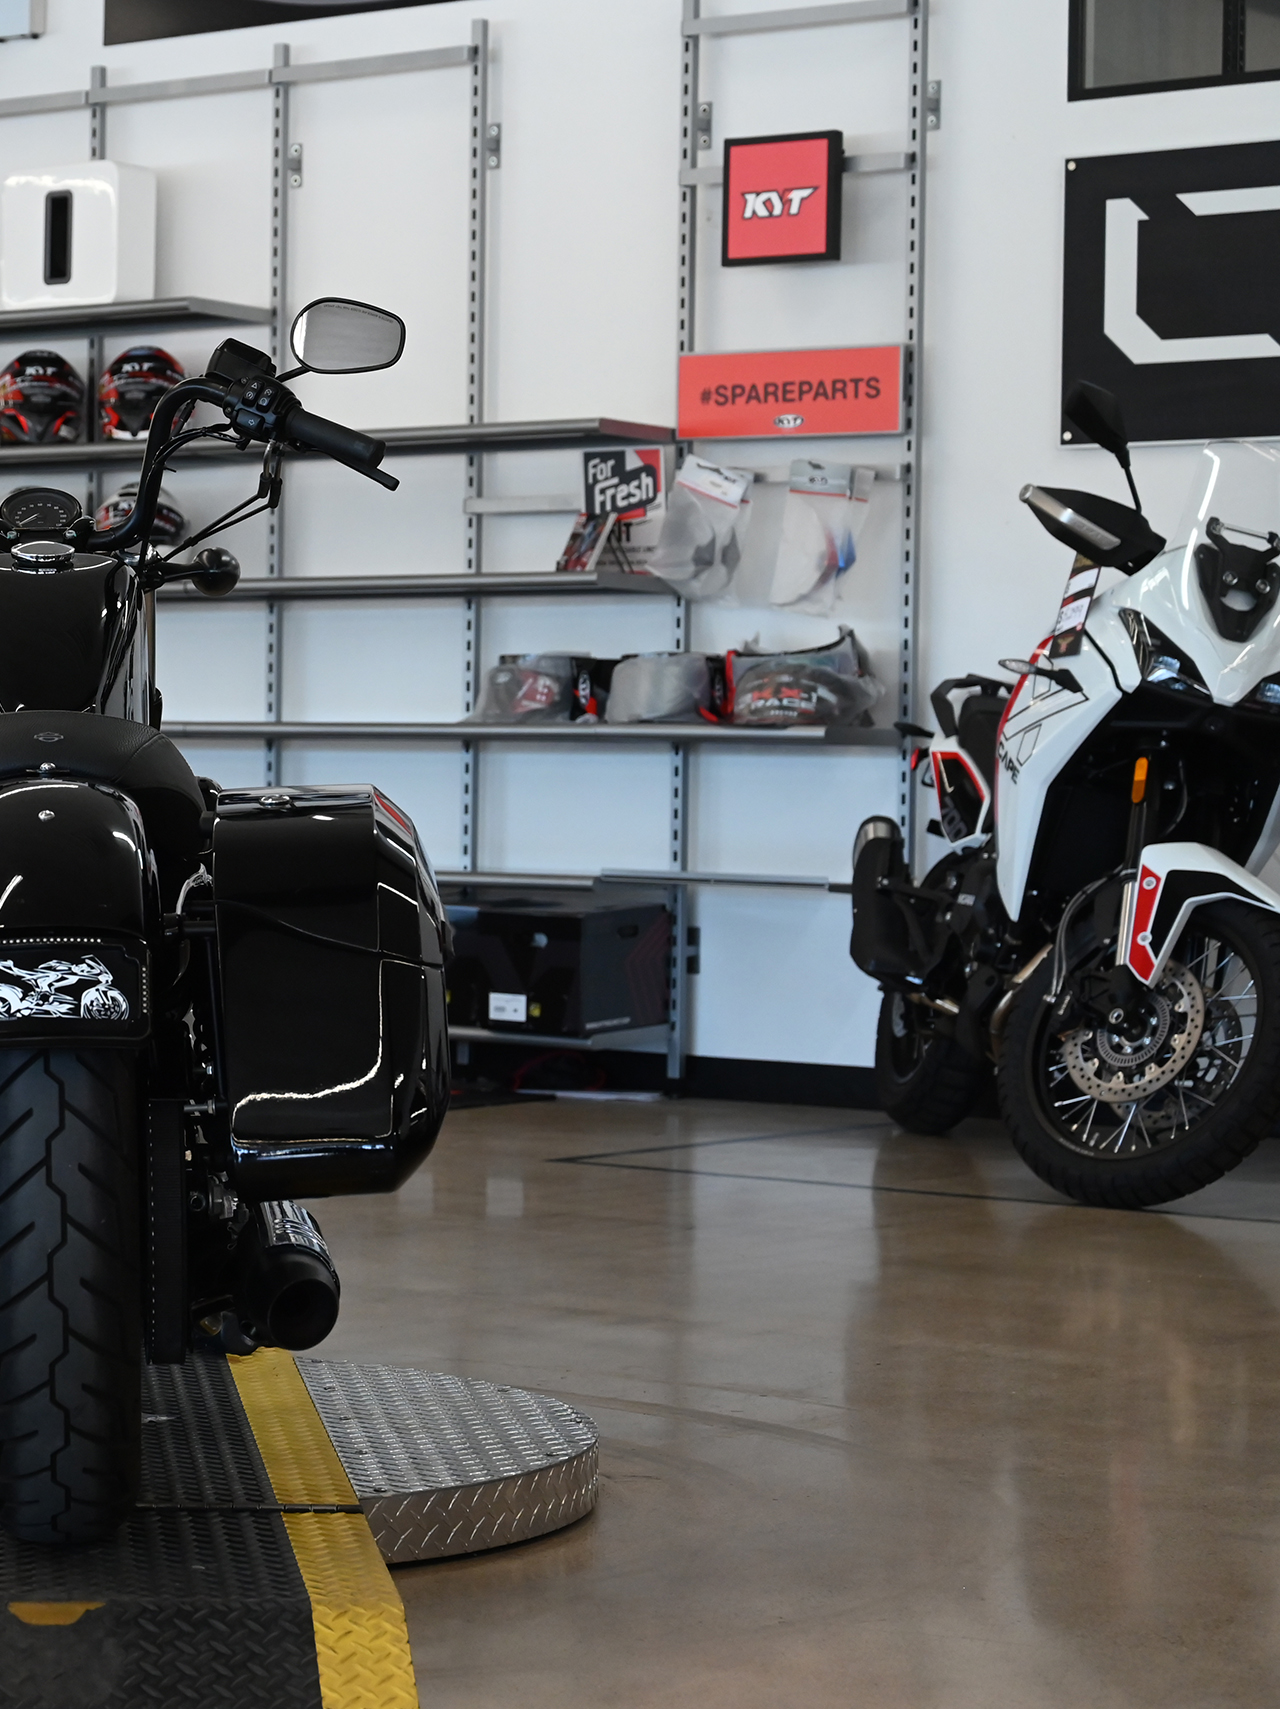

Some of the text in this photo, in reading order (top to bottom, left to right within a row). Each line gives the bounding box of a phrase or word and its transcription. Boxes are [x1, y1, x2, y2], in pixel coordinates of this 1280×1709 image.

[740, 185, 819, 220] KYT
[700, 376, 881, 407] #SPAREPARTS
[588, 457, 616, 485] For
[594, 471, 654, 515] Fresh
